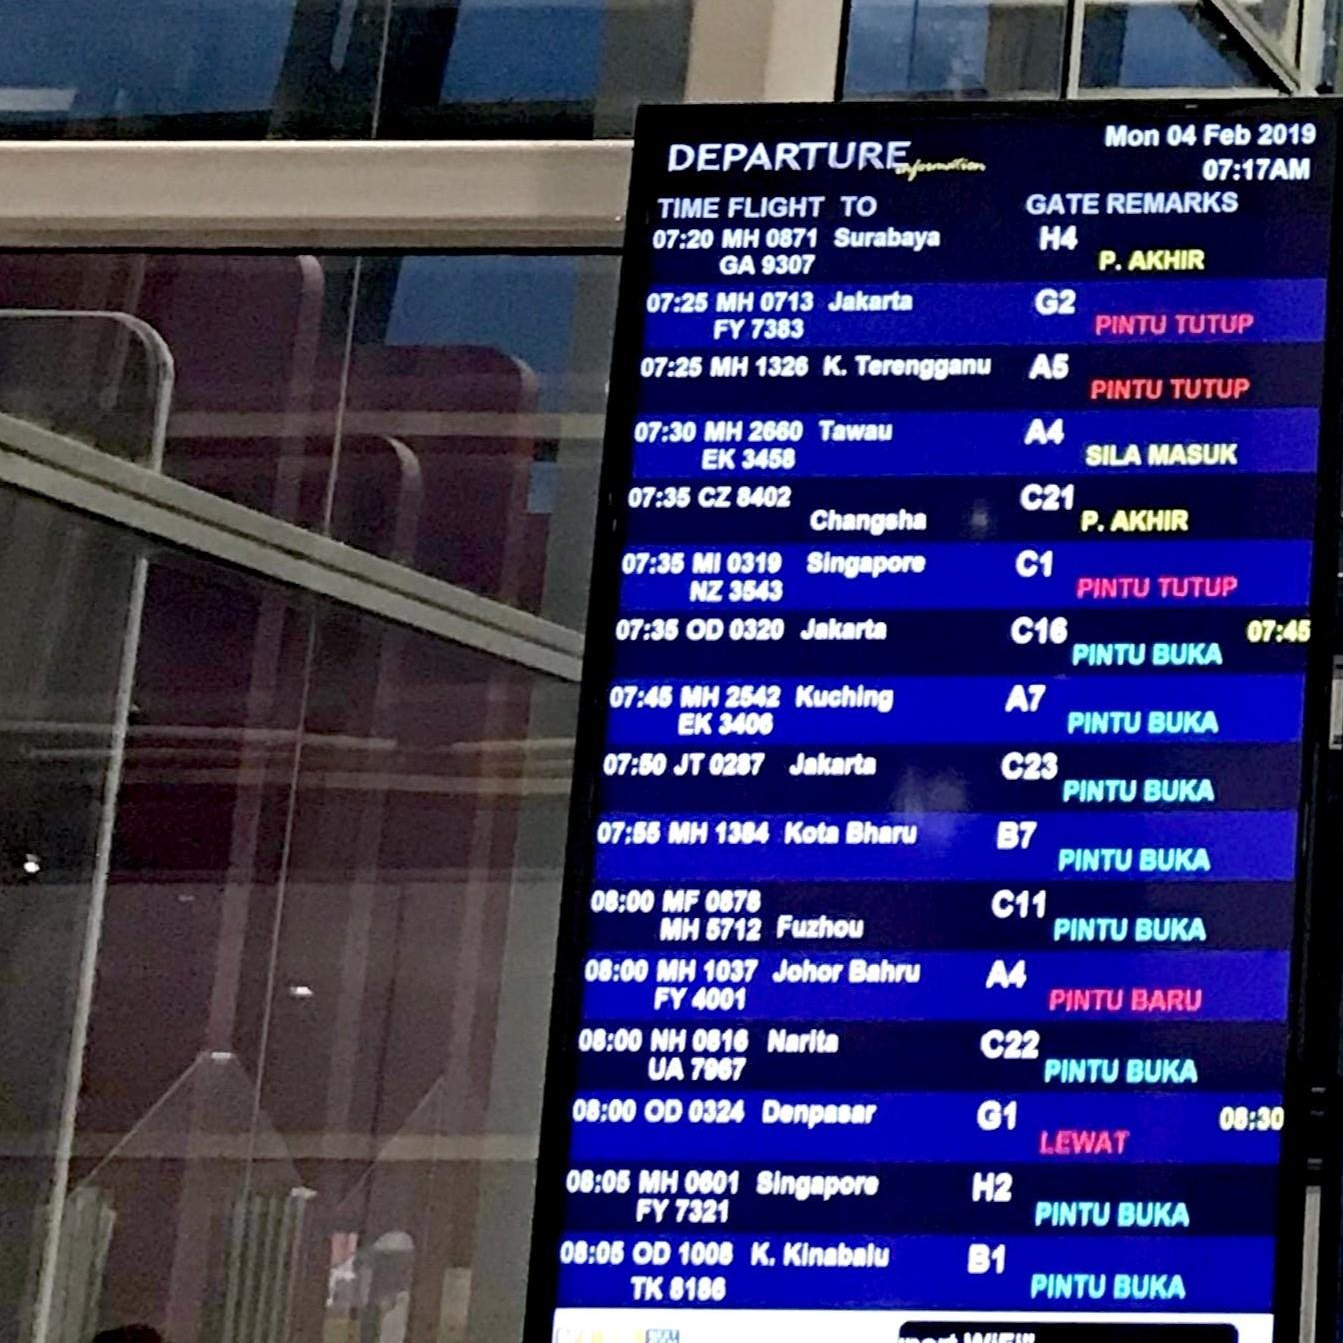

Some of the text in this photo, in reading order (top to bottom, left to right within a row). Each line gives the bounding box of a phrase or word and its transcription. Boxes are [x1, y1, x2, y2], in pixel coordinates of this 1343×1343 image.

[1106, 123, 1316, 146] Mon 04 Feb 2019
[668, 141, 911, 173] DEPARTURE
[1203, 158, 1310, 180] 07:17AM
[658, 192, 1238, 218] TIME FLIGHT TO GATE REMARKS
[653, 226, 1078, 251] 07:20 MH 0871 Surabaya H4
[720, 249, 1204, 274] GA 9307 P. AKHIR
[828, 289, 1076, 315] Jakarta G2
[1096, 314, 1253, 335] PINTU TUTUP
[823, 354, 1068, 380] K. Terengganu A5
[819, 420, 892, 441] Tawau
[1086, 444, 1237, 466] SILA MASUK
[1021, 484, 1074, 510] C21
[810, 509, 926, 535] Changsha
[796, 685, 1046, 712] Kuching A7
[785, 821, 1037, 849] Kota Bharu B7
[773, 959, 920, 982] Johor Bahru
[1050, 989, 1202, 1011] PINTU BARU
[1040, 1131, 1129, 1154] LEWAT
[1031, 1274, 1185, 1299] PINTU BUKA
